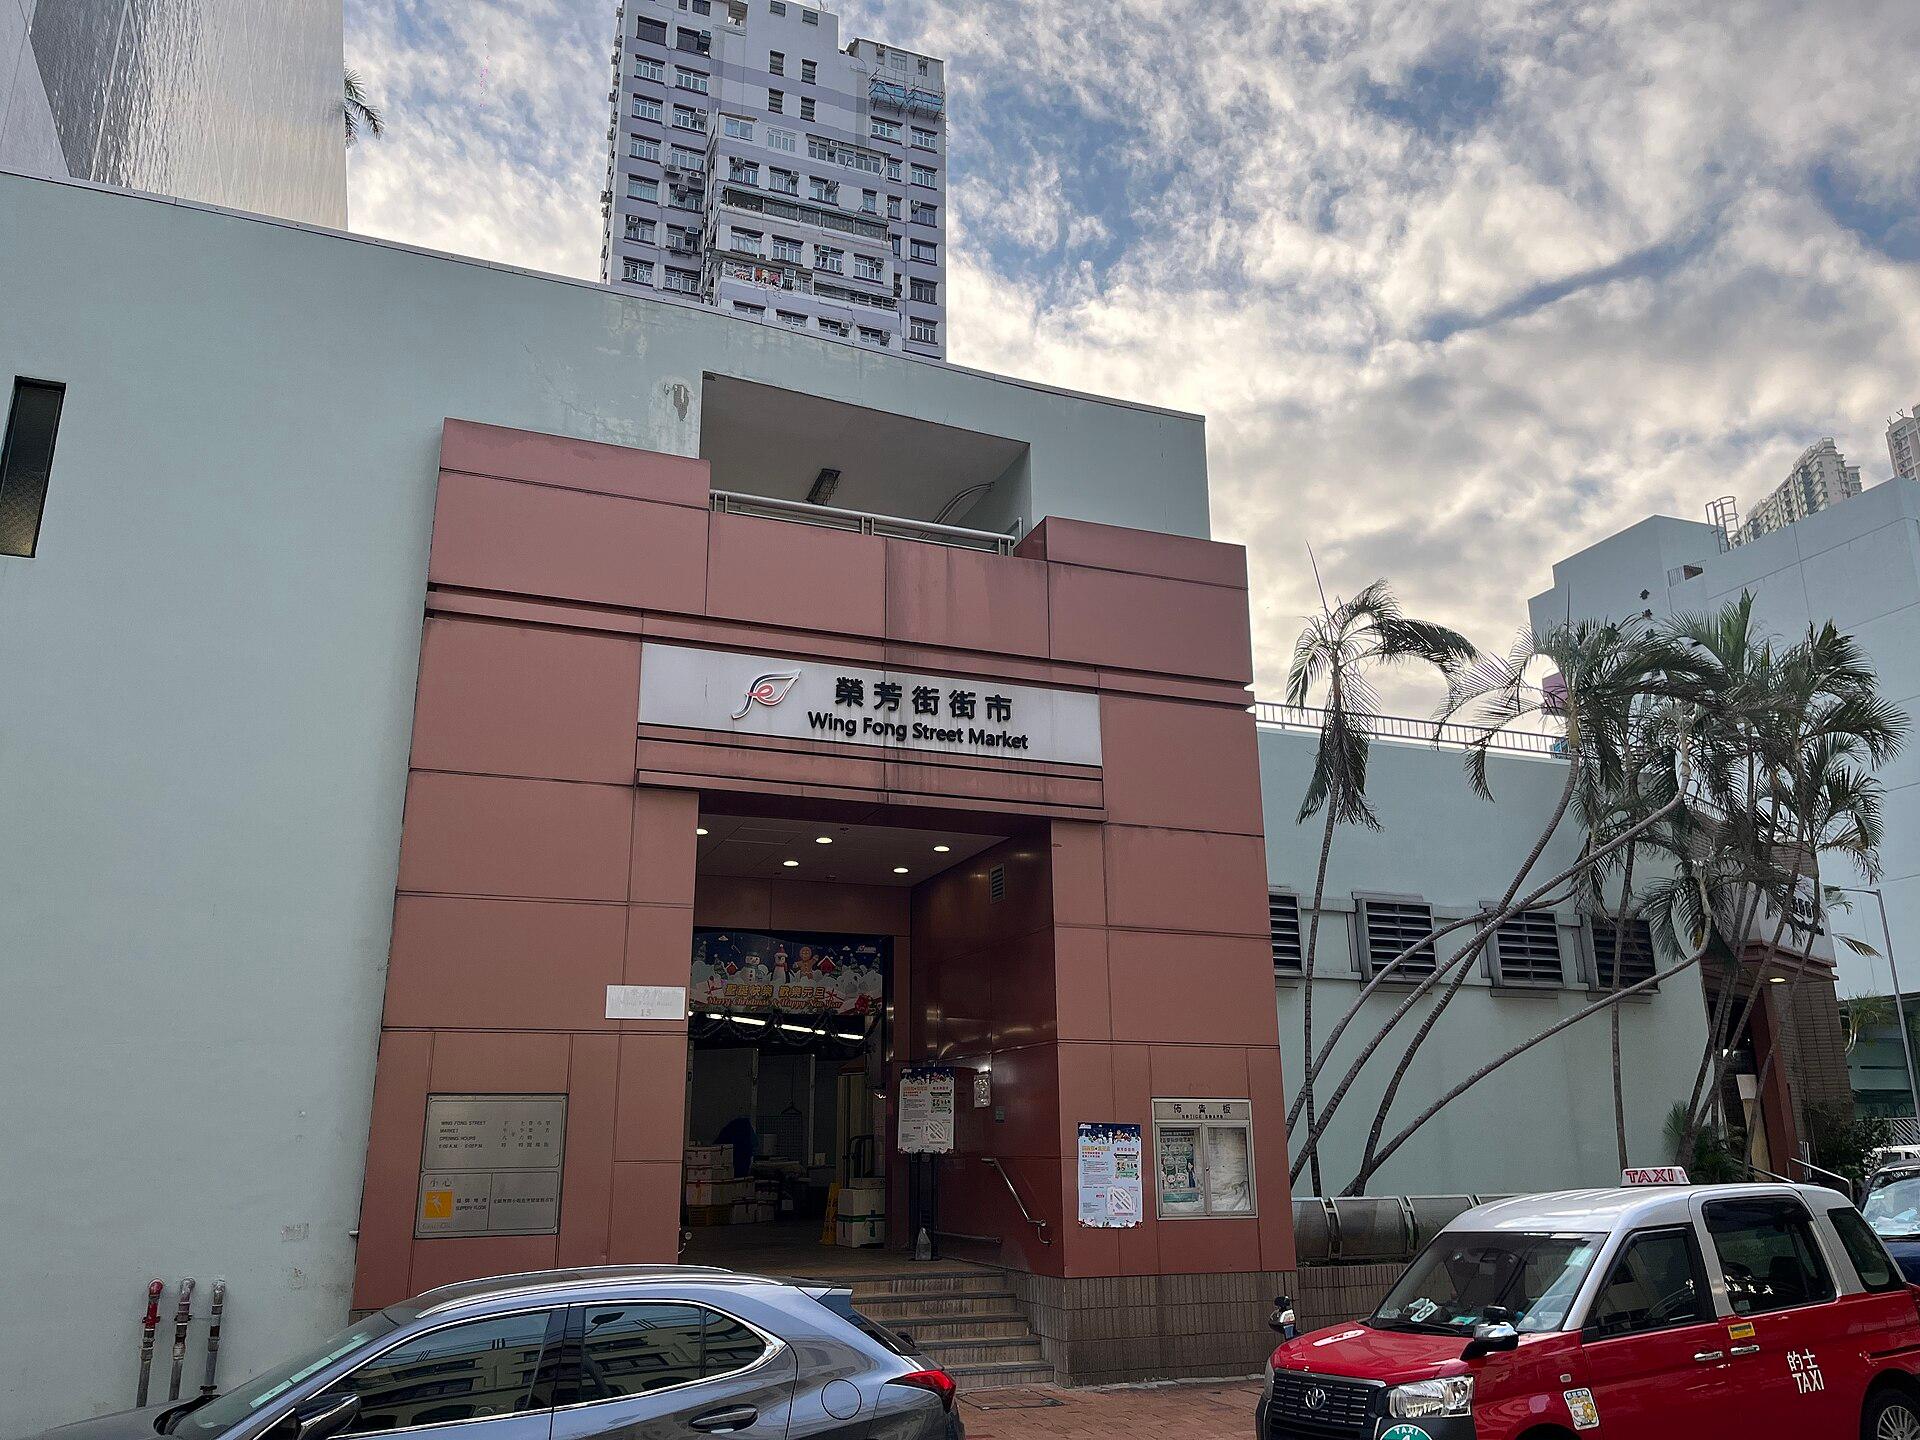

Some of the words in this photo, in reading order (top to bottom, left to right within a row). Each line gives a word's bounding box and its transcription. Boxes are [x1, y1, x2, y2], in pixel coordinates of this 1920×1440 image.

[835, 677, 1013, 723] 榮芳街街市
[808, 711, 858, 736] Wing
[863, 717, 908, 741] Fong
[912, 722, 964, 744] Street
[968, 730, 1029, 750] Market
[1626, 1169, 1674, 1183] TAXI
[1787, 1348, 1818, 1371] 的士
[1792, 1369, 1824, 1394] TAXI
[1394, 1426, 1419, 1435] TAXI
